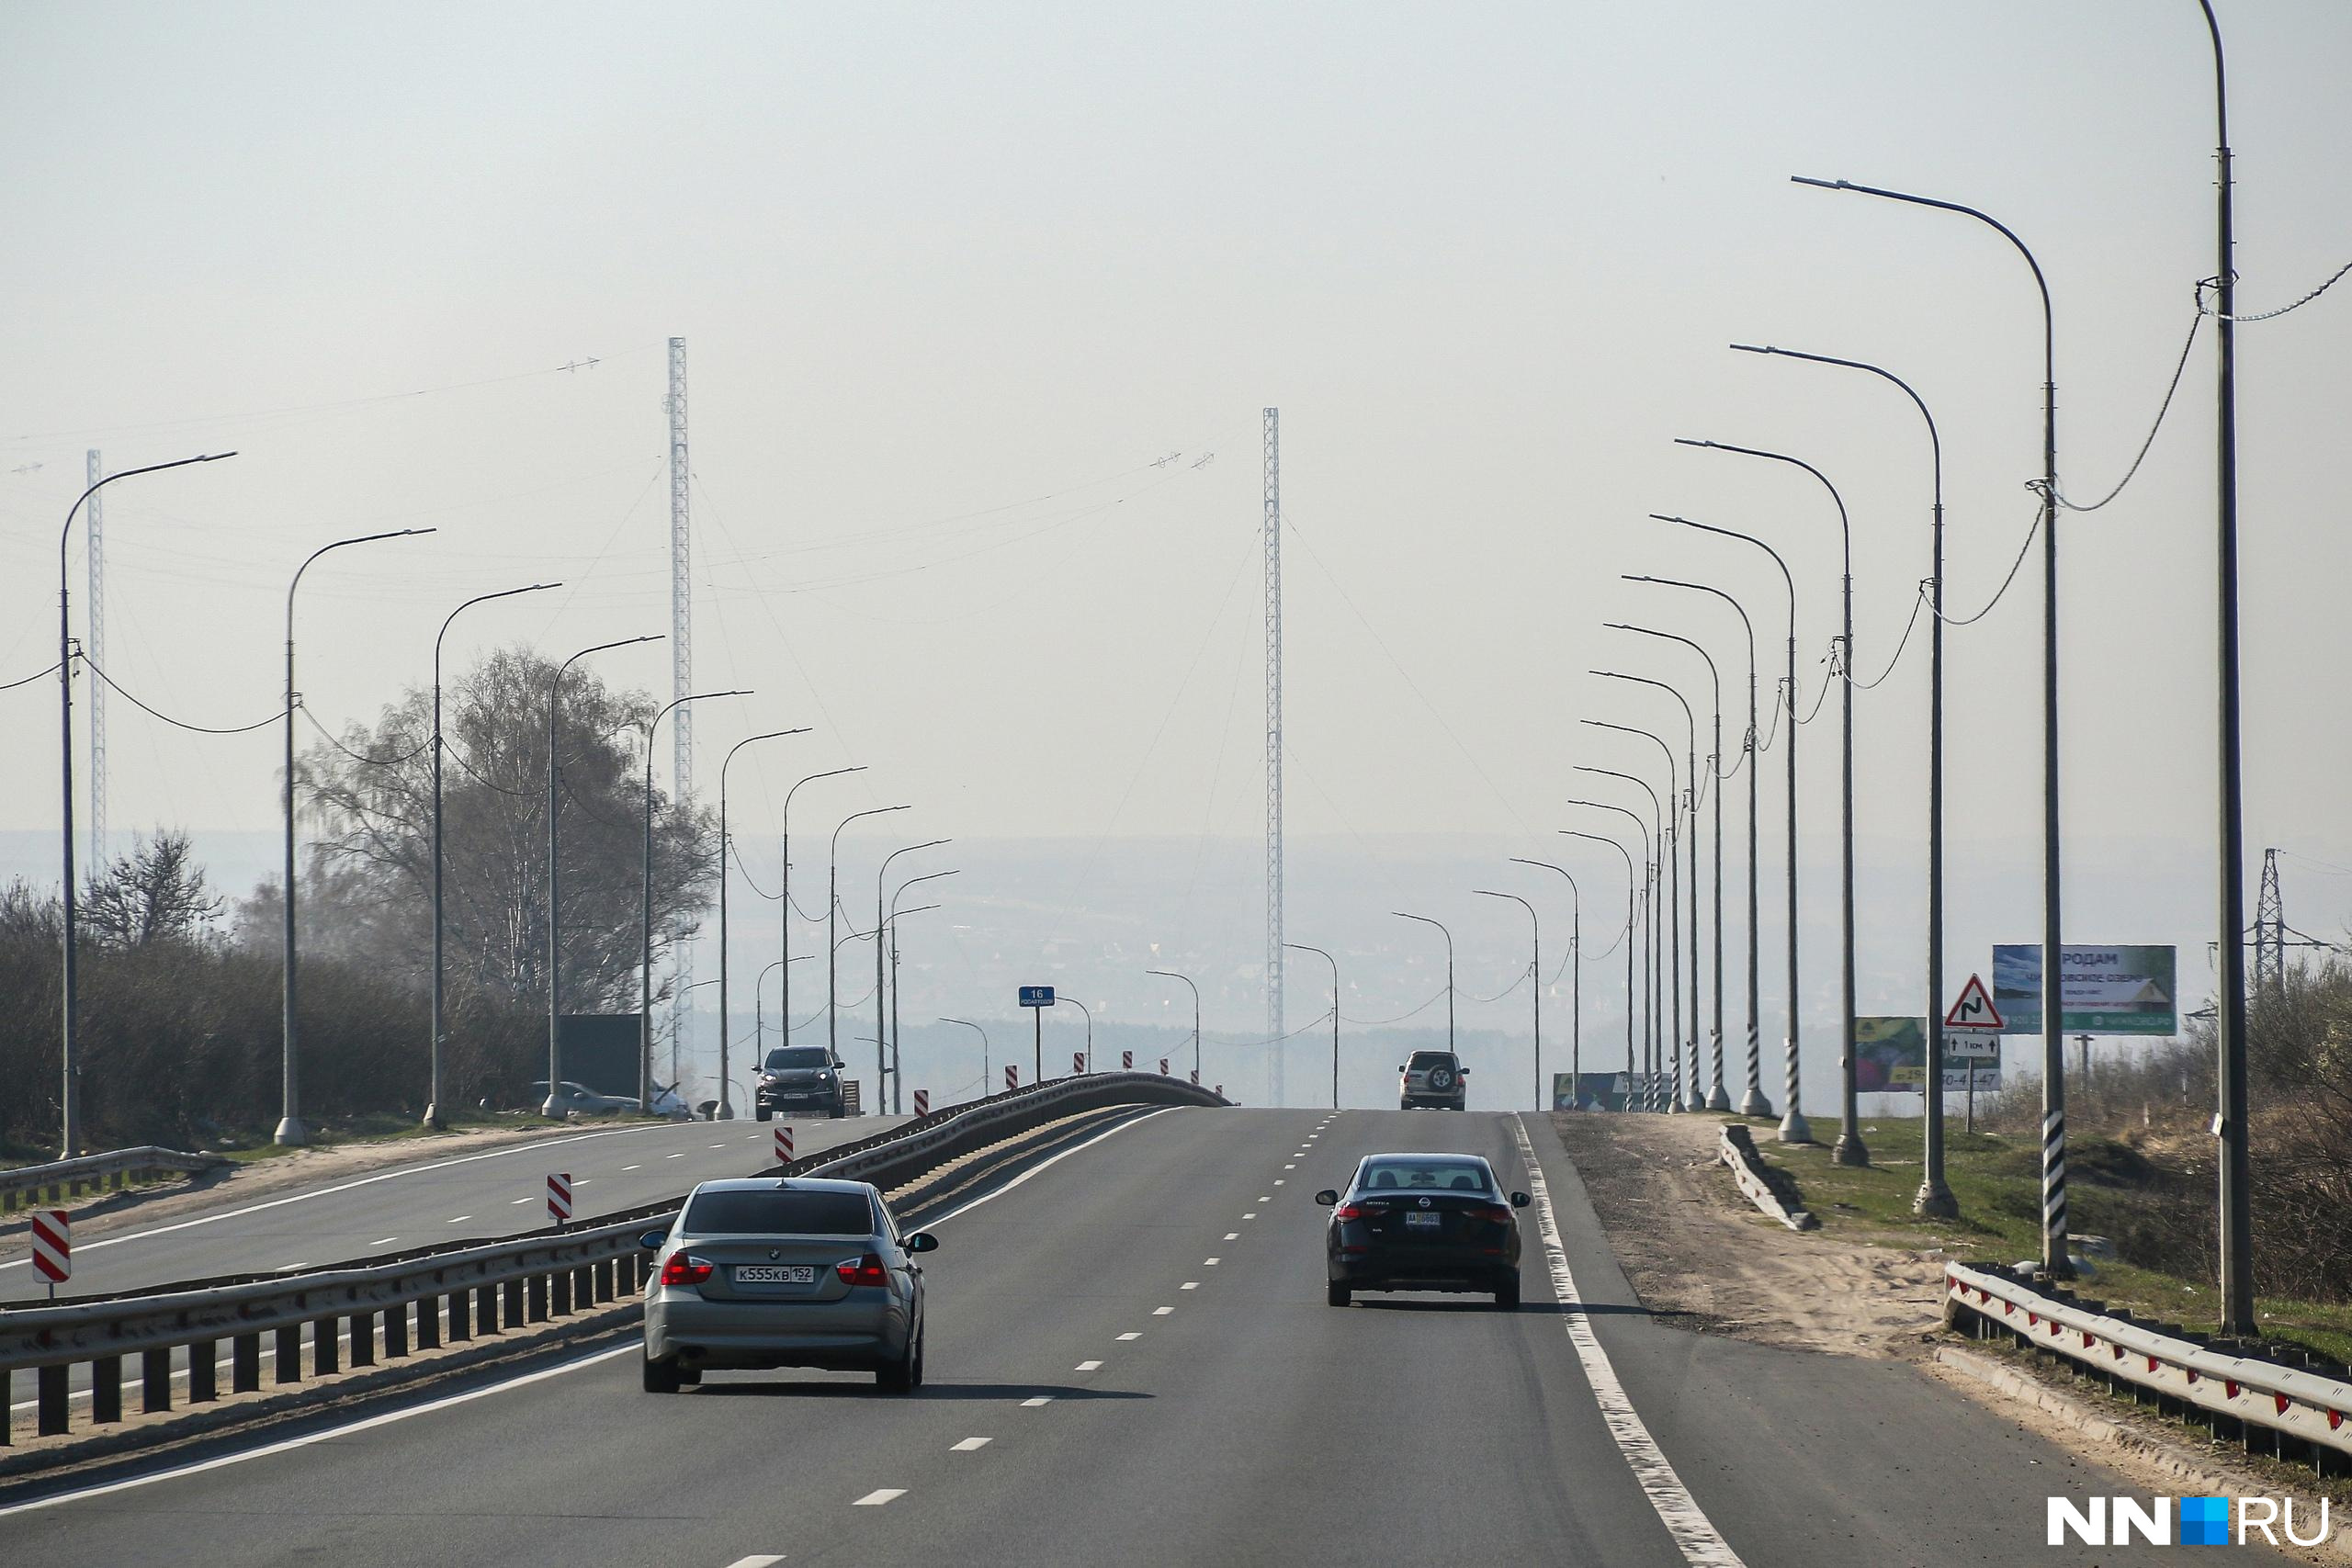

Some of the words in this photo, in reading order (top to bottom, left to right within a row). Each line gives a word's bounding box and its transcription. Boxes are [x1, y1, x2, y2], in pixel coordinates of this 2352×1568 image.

[2061, 953, 2118, 968] РОДАМ
[1030, 988, 1044, 999] 16
[740, 1268, 789, 1280] К555КВ
[792, 1268, 811, 1278] 152
